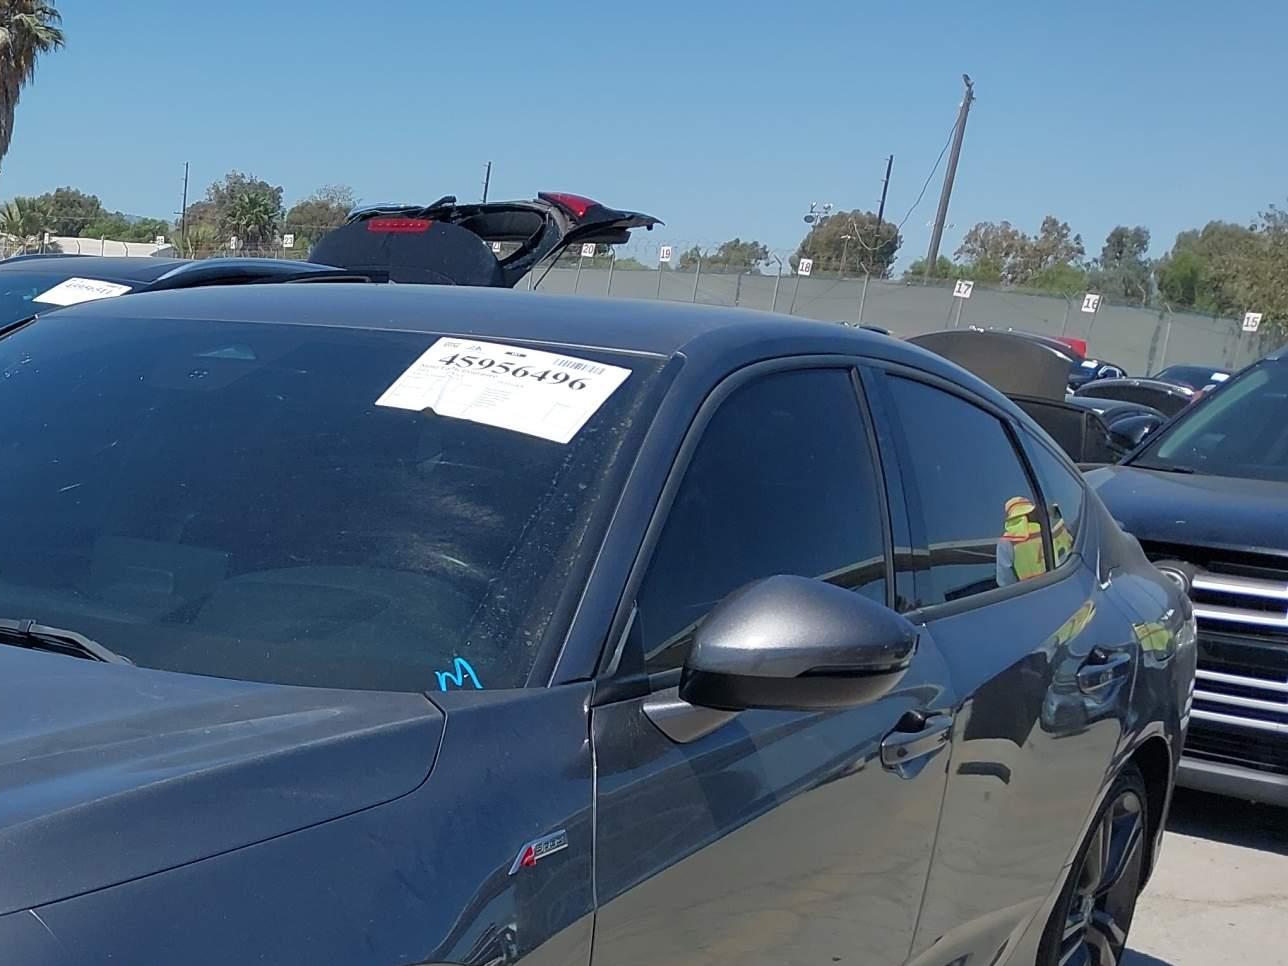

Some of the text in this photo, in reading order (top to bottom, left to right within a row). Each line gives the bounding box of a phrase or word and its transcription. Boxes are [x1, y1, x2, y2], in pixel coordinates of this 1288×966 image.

[582, 244, 594, 254] 20
[661, 248, 671, 259] 19
[799, 261, 811, 273] 18
[956, 282, 972, 295] 17
[1243, 316, 1260, 328] 15
[437, 352, 593, 391] 45956496
